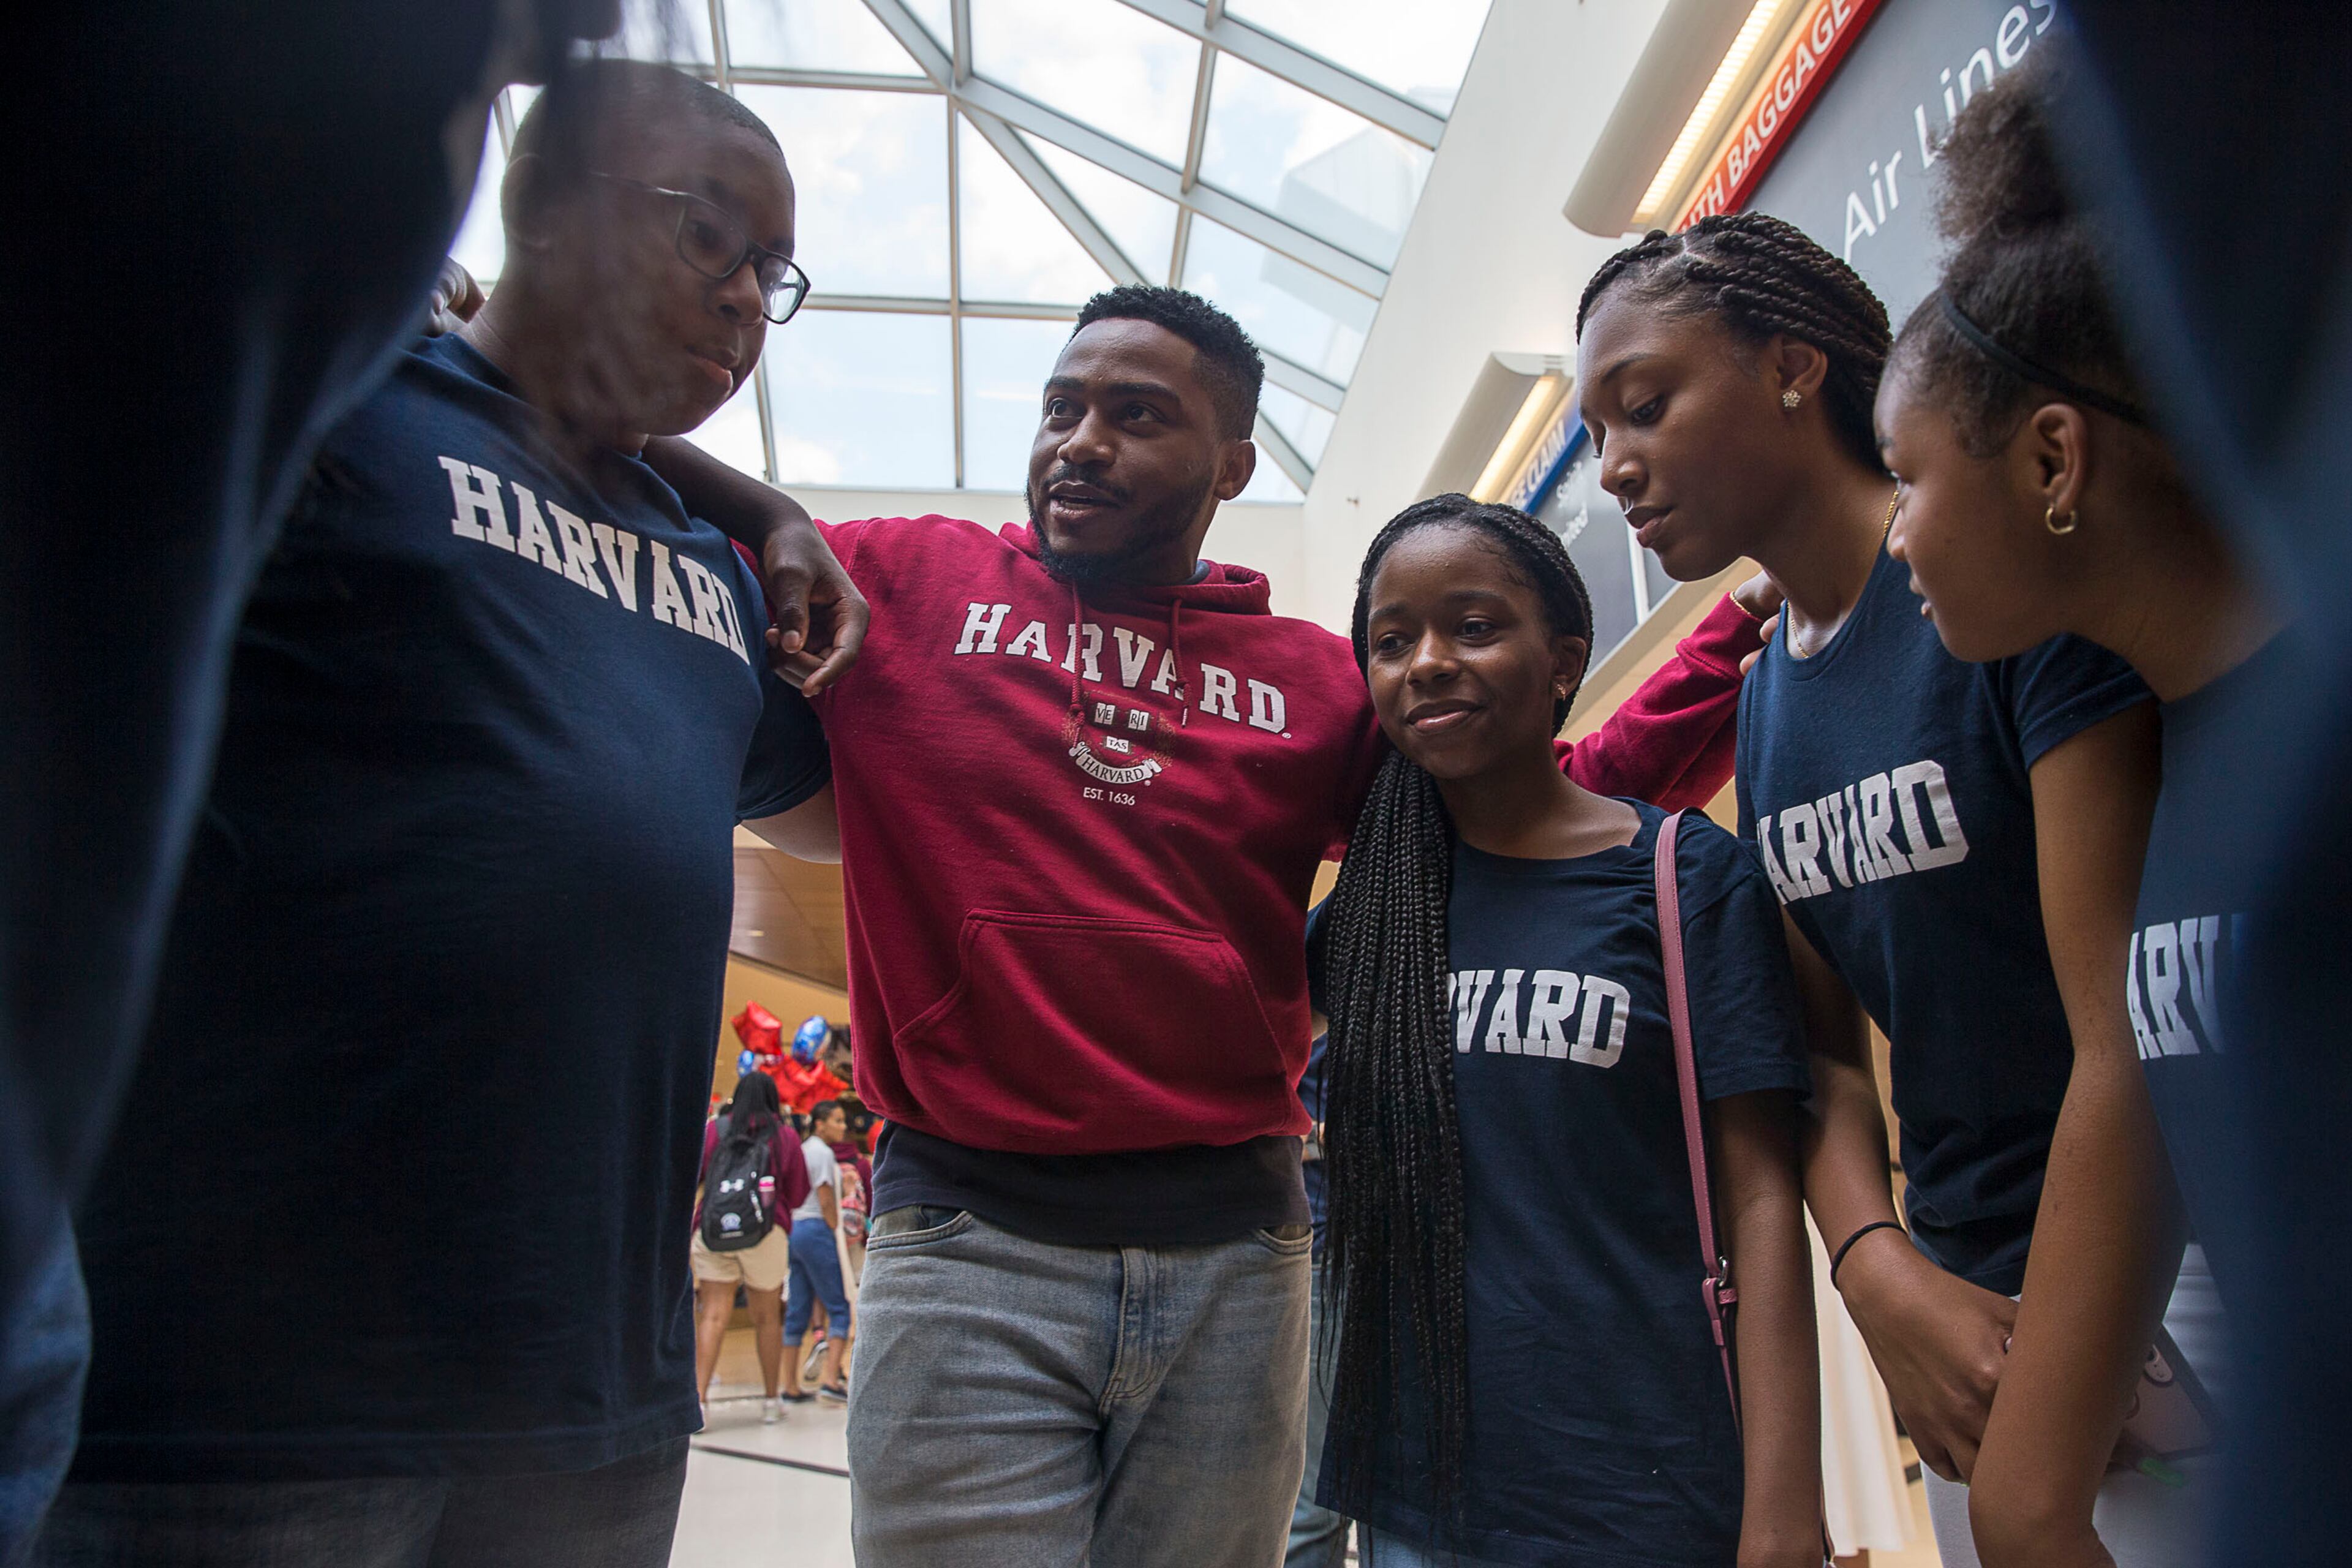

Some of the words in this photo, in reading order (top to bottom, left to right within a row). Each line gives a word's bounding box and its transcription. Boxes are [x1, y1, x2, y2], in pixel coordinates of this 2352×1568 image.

[1726, 0, 1850, 189] BAGGAGE
[1844, 150, 1902, 264] Air
[1914, 0, 2057, 169] Lines
[437, 456, 750, 665] HARVARD
[954, 602, 1286, 734] HARVARD
[1082, 756, 1144, 783] HARVARD
[1084, 787, 1104, 801] EST.
[1109, 791, 1135, 805] 1636
[1757, 760, 1969, 905] ARVARD
[2127, 914, 2244, 1060] ARV
